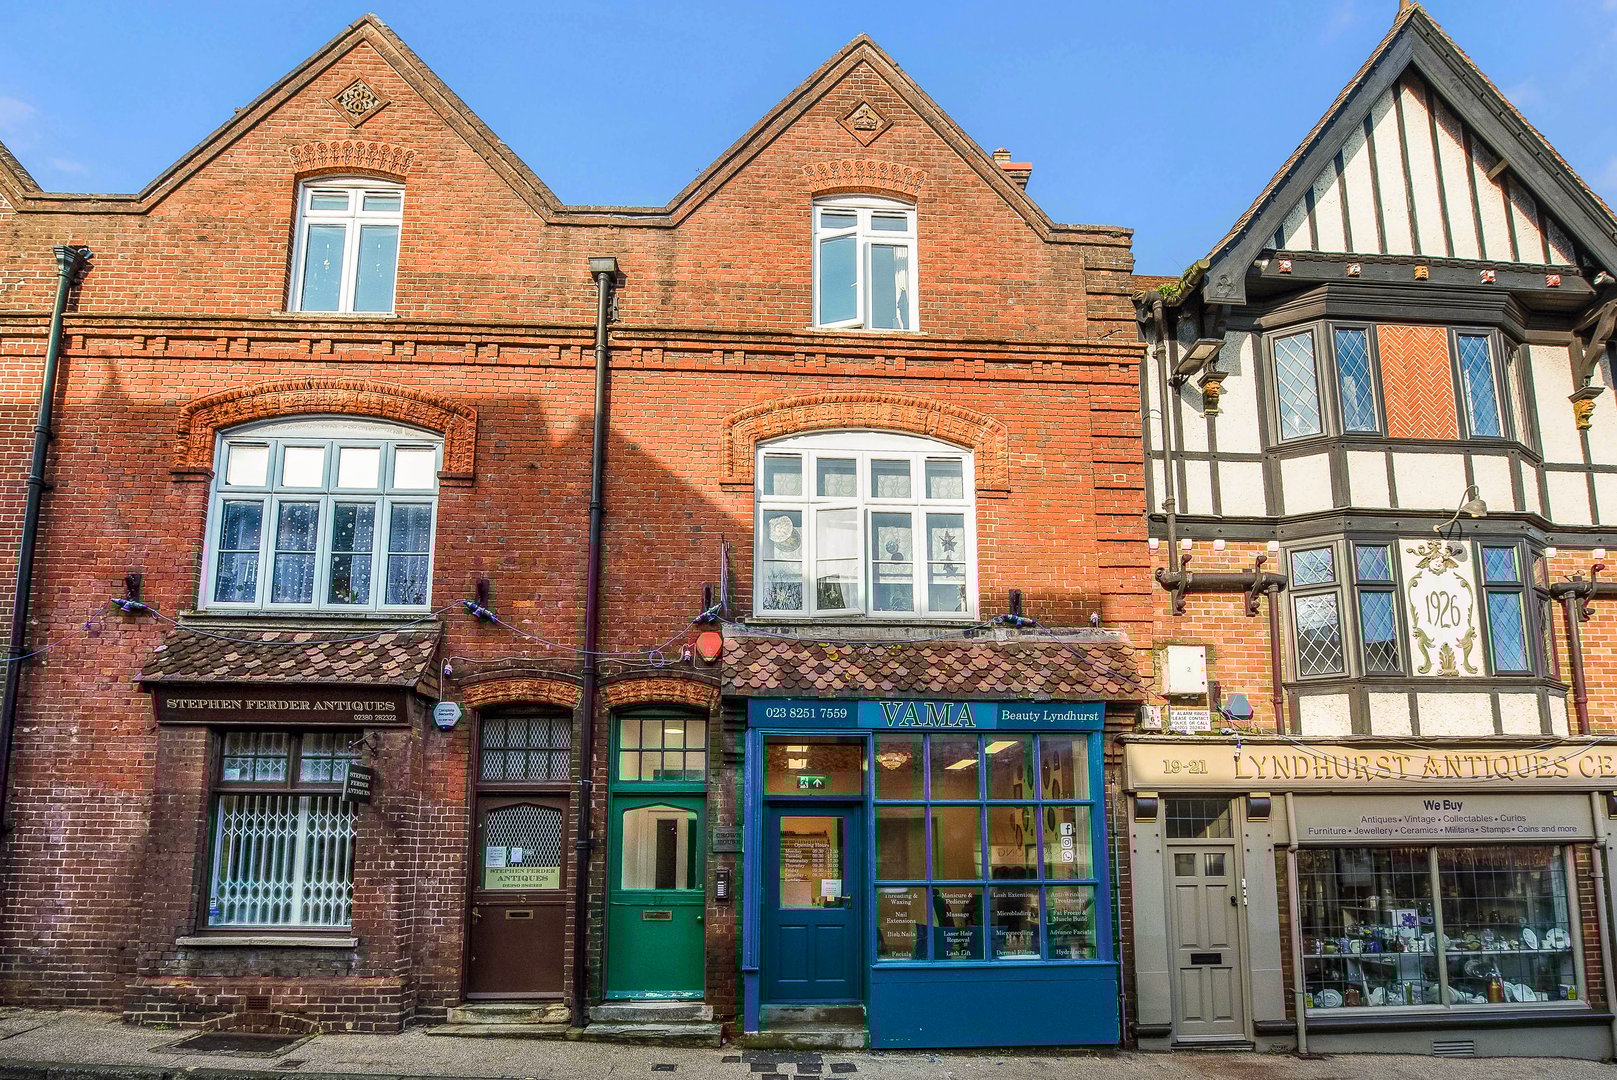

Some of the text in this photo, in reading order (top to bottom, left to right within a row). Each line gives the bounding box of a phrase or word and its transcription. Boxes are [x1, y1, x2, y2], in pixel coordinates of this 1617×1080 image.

[1425, 591, 1462, 628] 1926
[166, 698, 396, 712] STEPHEN FERDER ANTIQUES
[766, 707, 848, 718] 023 8251 7559
[880, 702, 977, 727] VAMA
[1001, 710, 1100, 722] Beauty Lyndhurst
[1162, 760, 1208, 774] 19-21
[1234, 754, 1410, 781] LYNDHURST
[1420, 754, 1570, 781] ANTIQUES
[1424, 800, 1462, 813] We Buy
[1360, 813, 1526, 825] Antiques Vintage Collectables Curios
[1308, 826, 1346, 836] Furniture
[1353, 826, 1393, 838] Jewellery
[1400, 826, 1438, 836] Ceramics
[1444, 826, 1475, 836] Militaria
[1480, 825, 1512, 837] Stamps
[1517, 825, 1539, 834] Coins
[1541, 825, 1554, 834] and
